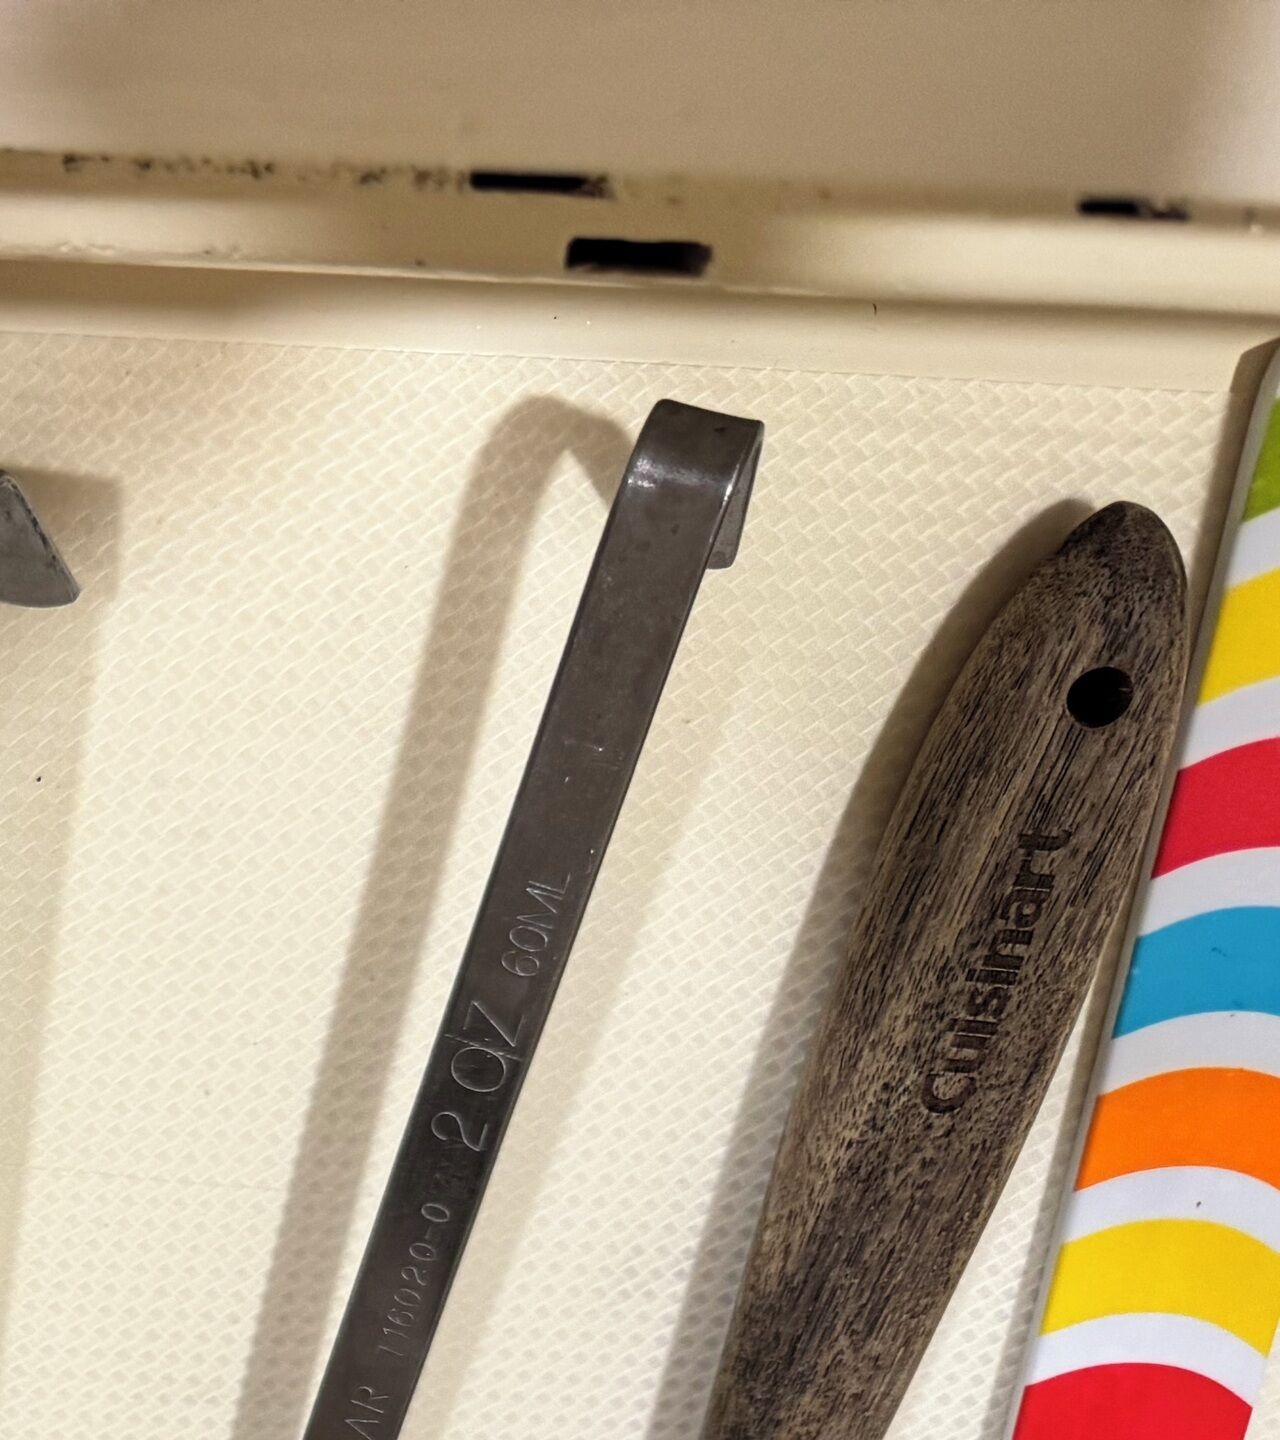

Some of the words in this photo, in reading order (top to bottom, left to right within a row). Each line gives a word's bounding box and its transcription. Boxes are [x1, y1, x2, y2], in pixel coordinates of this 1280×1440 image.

[500, 872, 572, 978] 60ML
[920, 828, 1073, 1114] Cuisinart
[449, 1000, 527, 1094] OZ
[429, 1110, 490, 1153] 2
